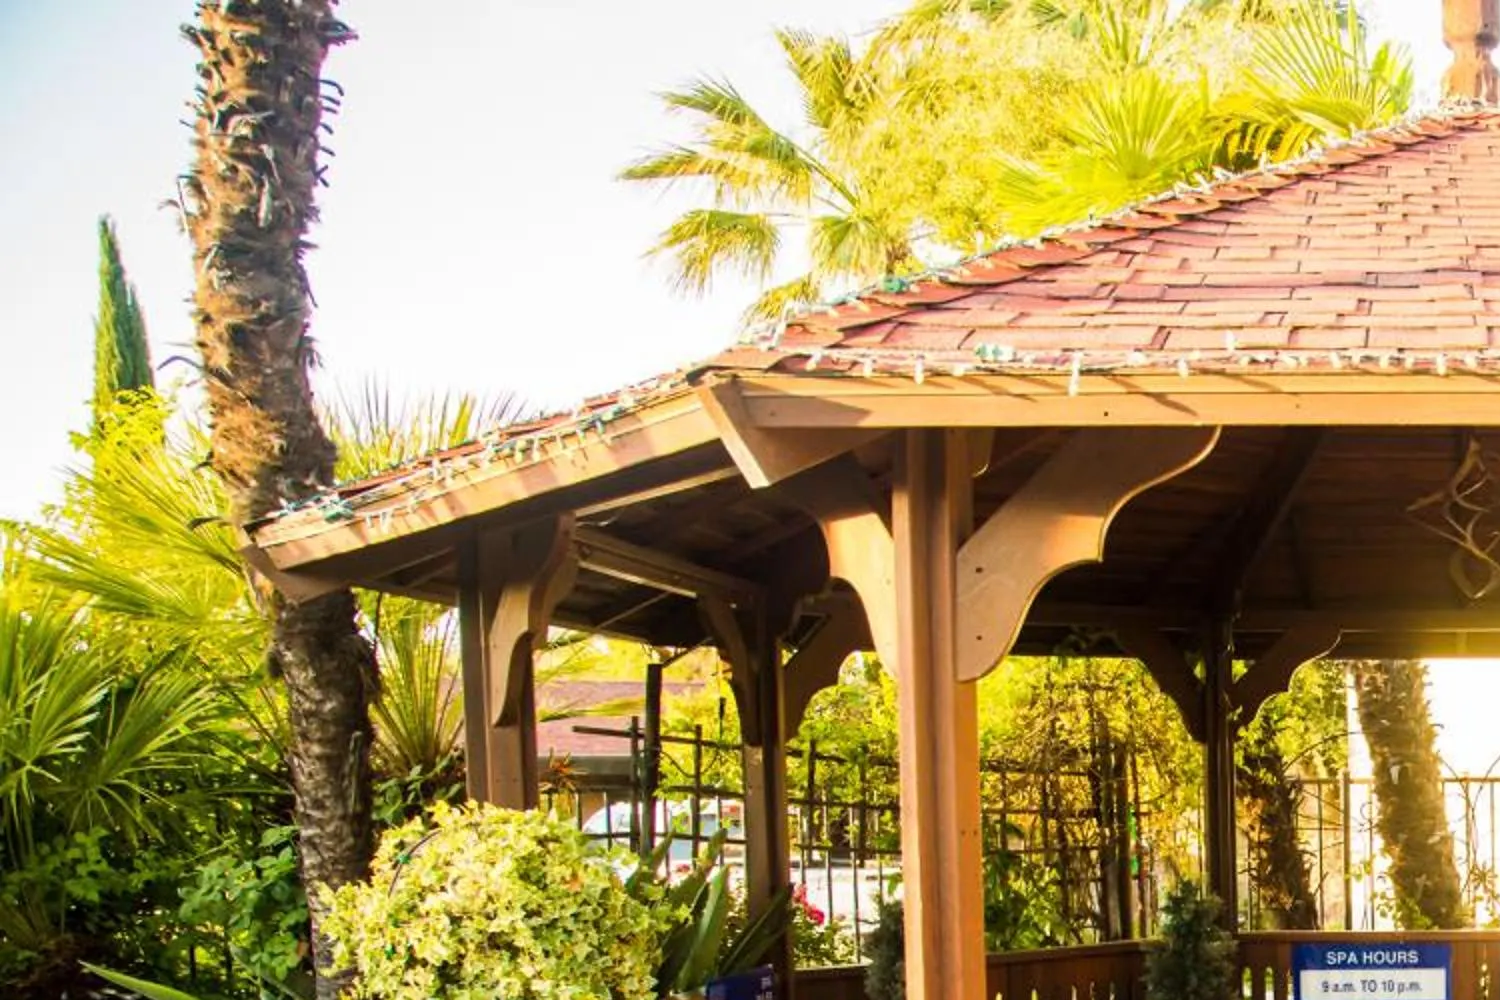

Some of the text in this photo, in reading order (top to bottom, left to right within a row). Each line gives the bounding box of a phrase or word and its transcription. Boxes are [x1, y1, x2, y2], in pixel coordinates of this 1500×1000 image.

[1326, 950, 1419, 965] SPA HOURS
[1321, 981, 1329, 993] 9
[1360, 980, 1378, 993] TO
[1381, 980, 1394, 993] 10
[1397, 982, 1422, 996] p.m.
